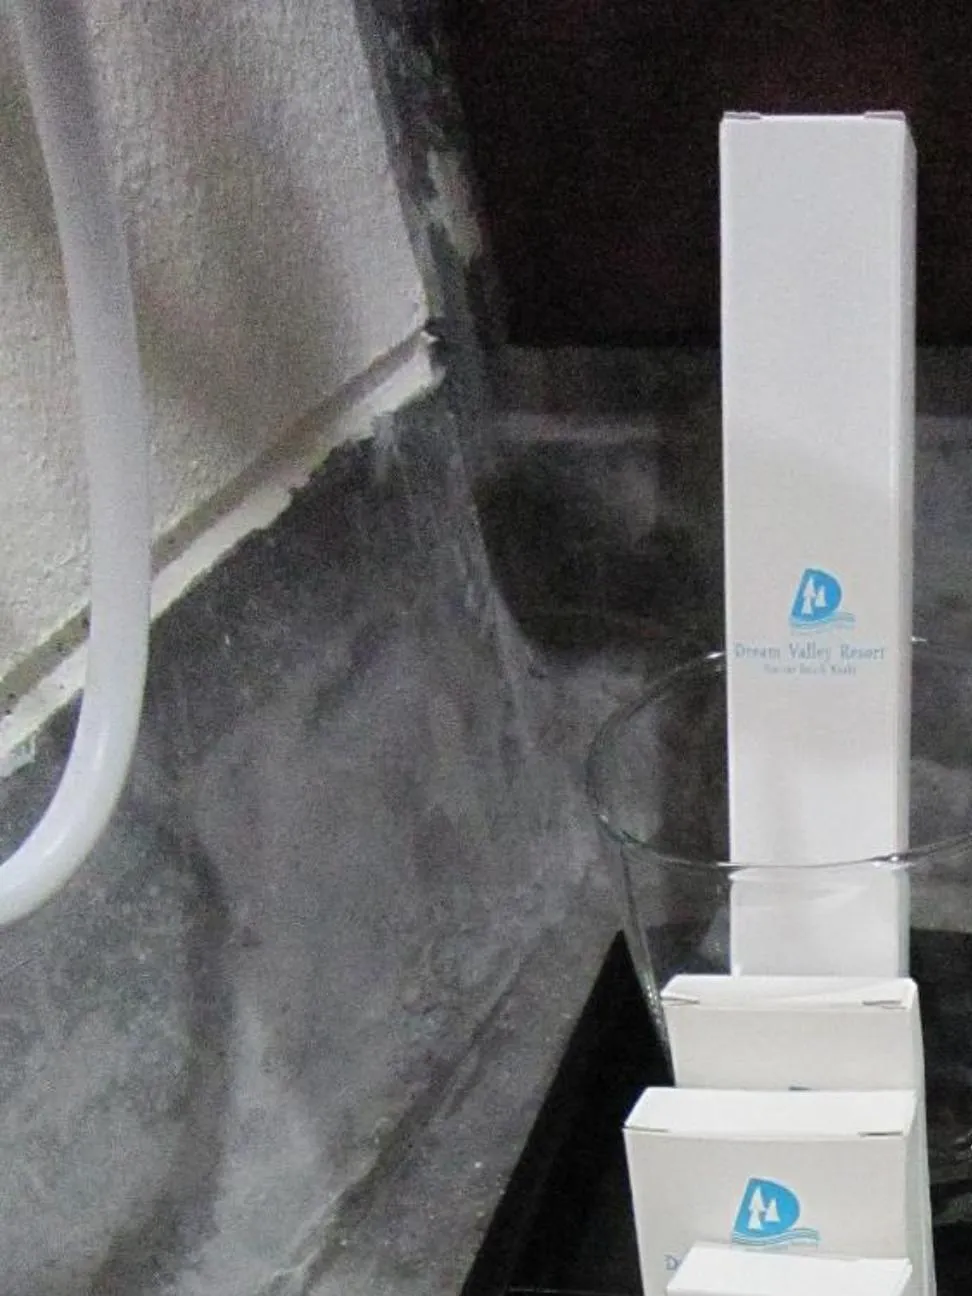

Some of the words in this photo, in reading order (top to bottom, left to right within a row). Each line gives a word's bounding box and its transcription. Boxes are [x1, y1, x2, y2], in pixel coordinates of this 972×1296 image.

[734, 643, 781, 659] Dream
[789, 642, 831, 662] Valley
[840, 643, 886, 660] Resort
